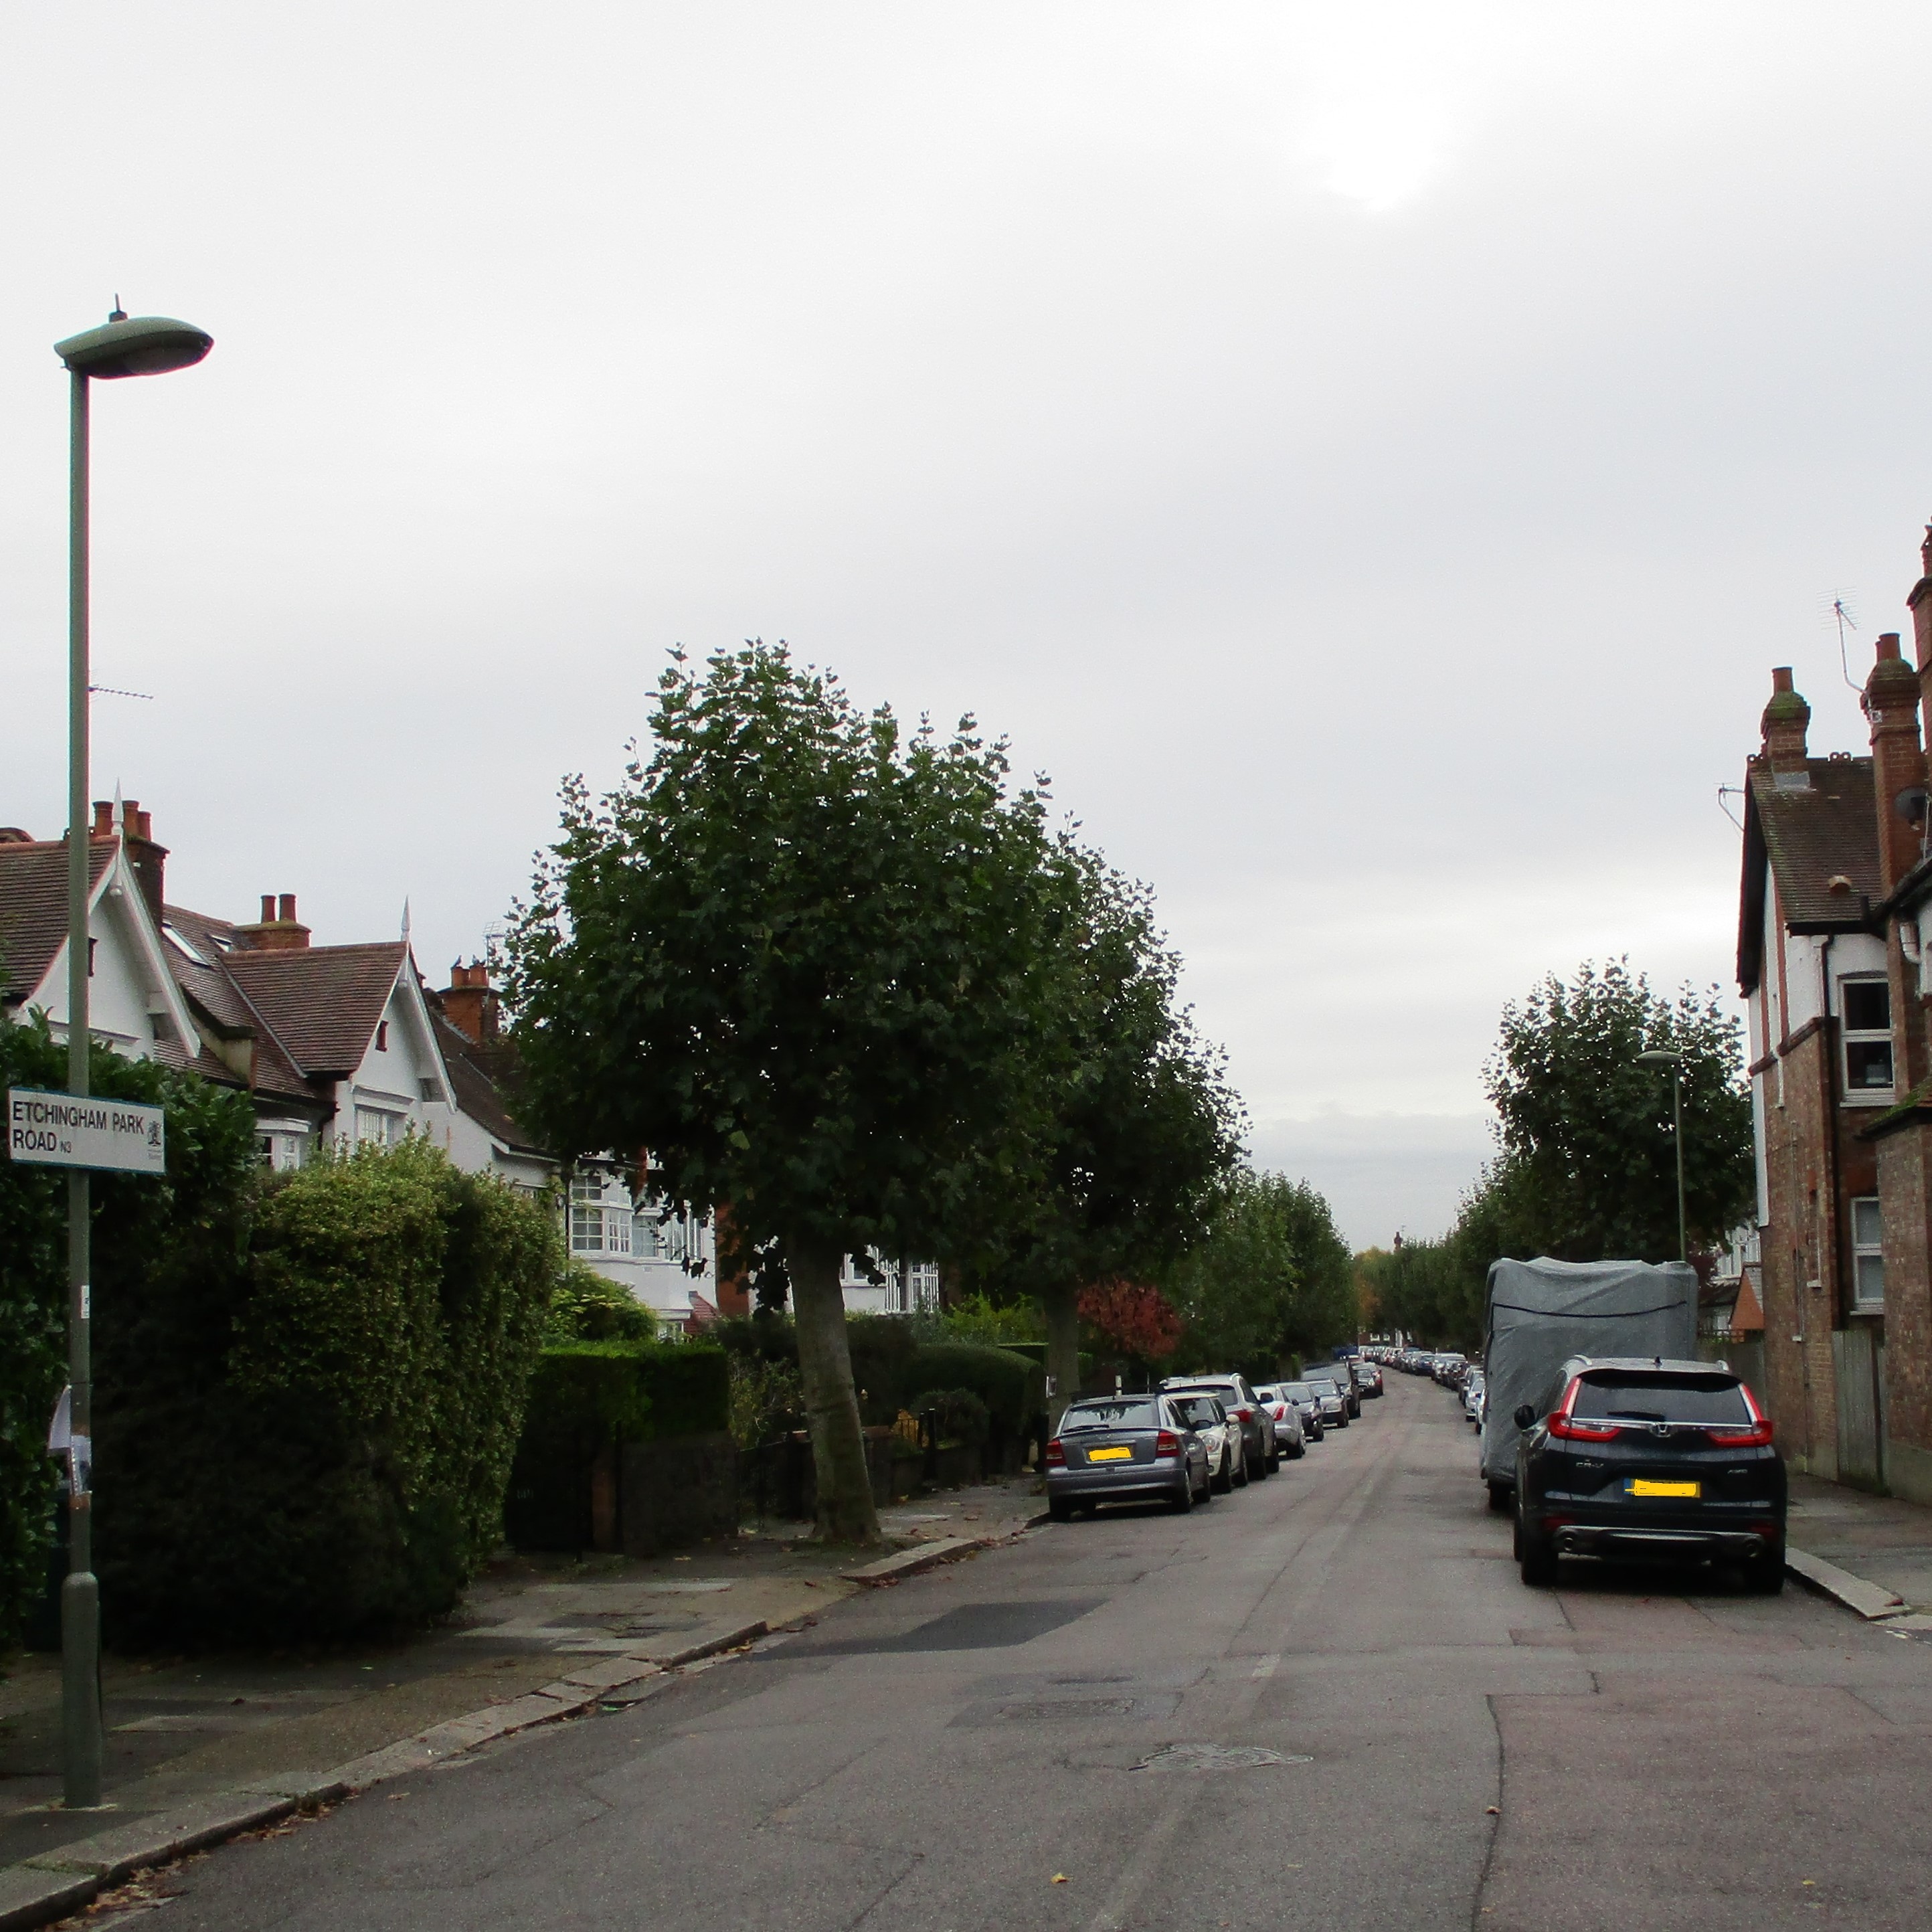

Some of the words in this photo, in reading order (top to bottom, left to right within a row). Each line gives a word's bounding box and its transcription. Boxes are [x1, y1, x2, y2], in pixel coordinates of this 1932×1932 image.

[13, 1100, 107, 1130] ETCHINGHAM
[112, 1112, 145, 1135] PARK
[13, 1129, 57, 1152] ROAD
[60, 1140, 72, 1153] N3
